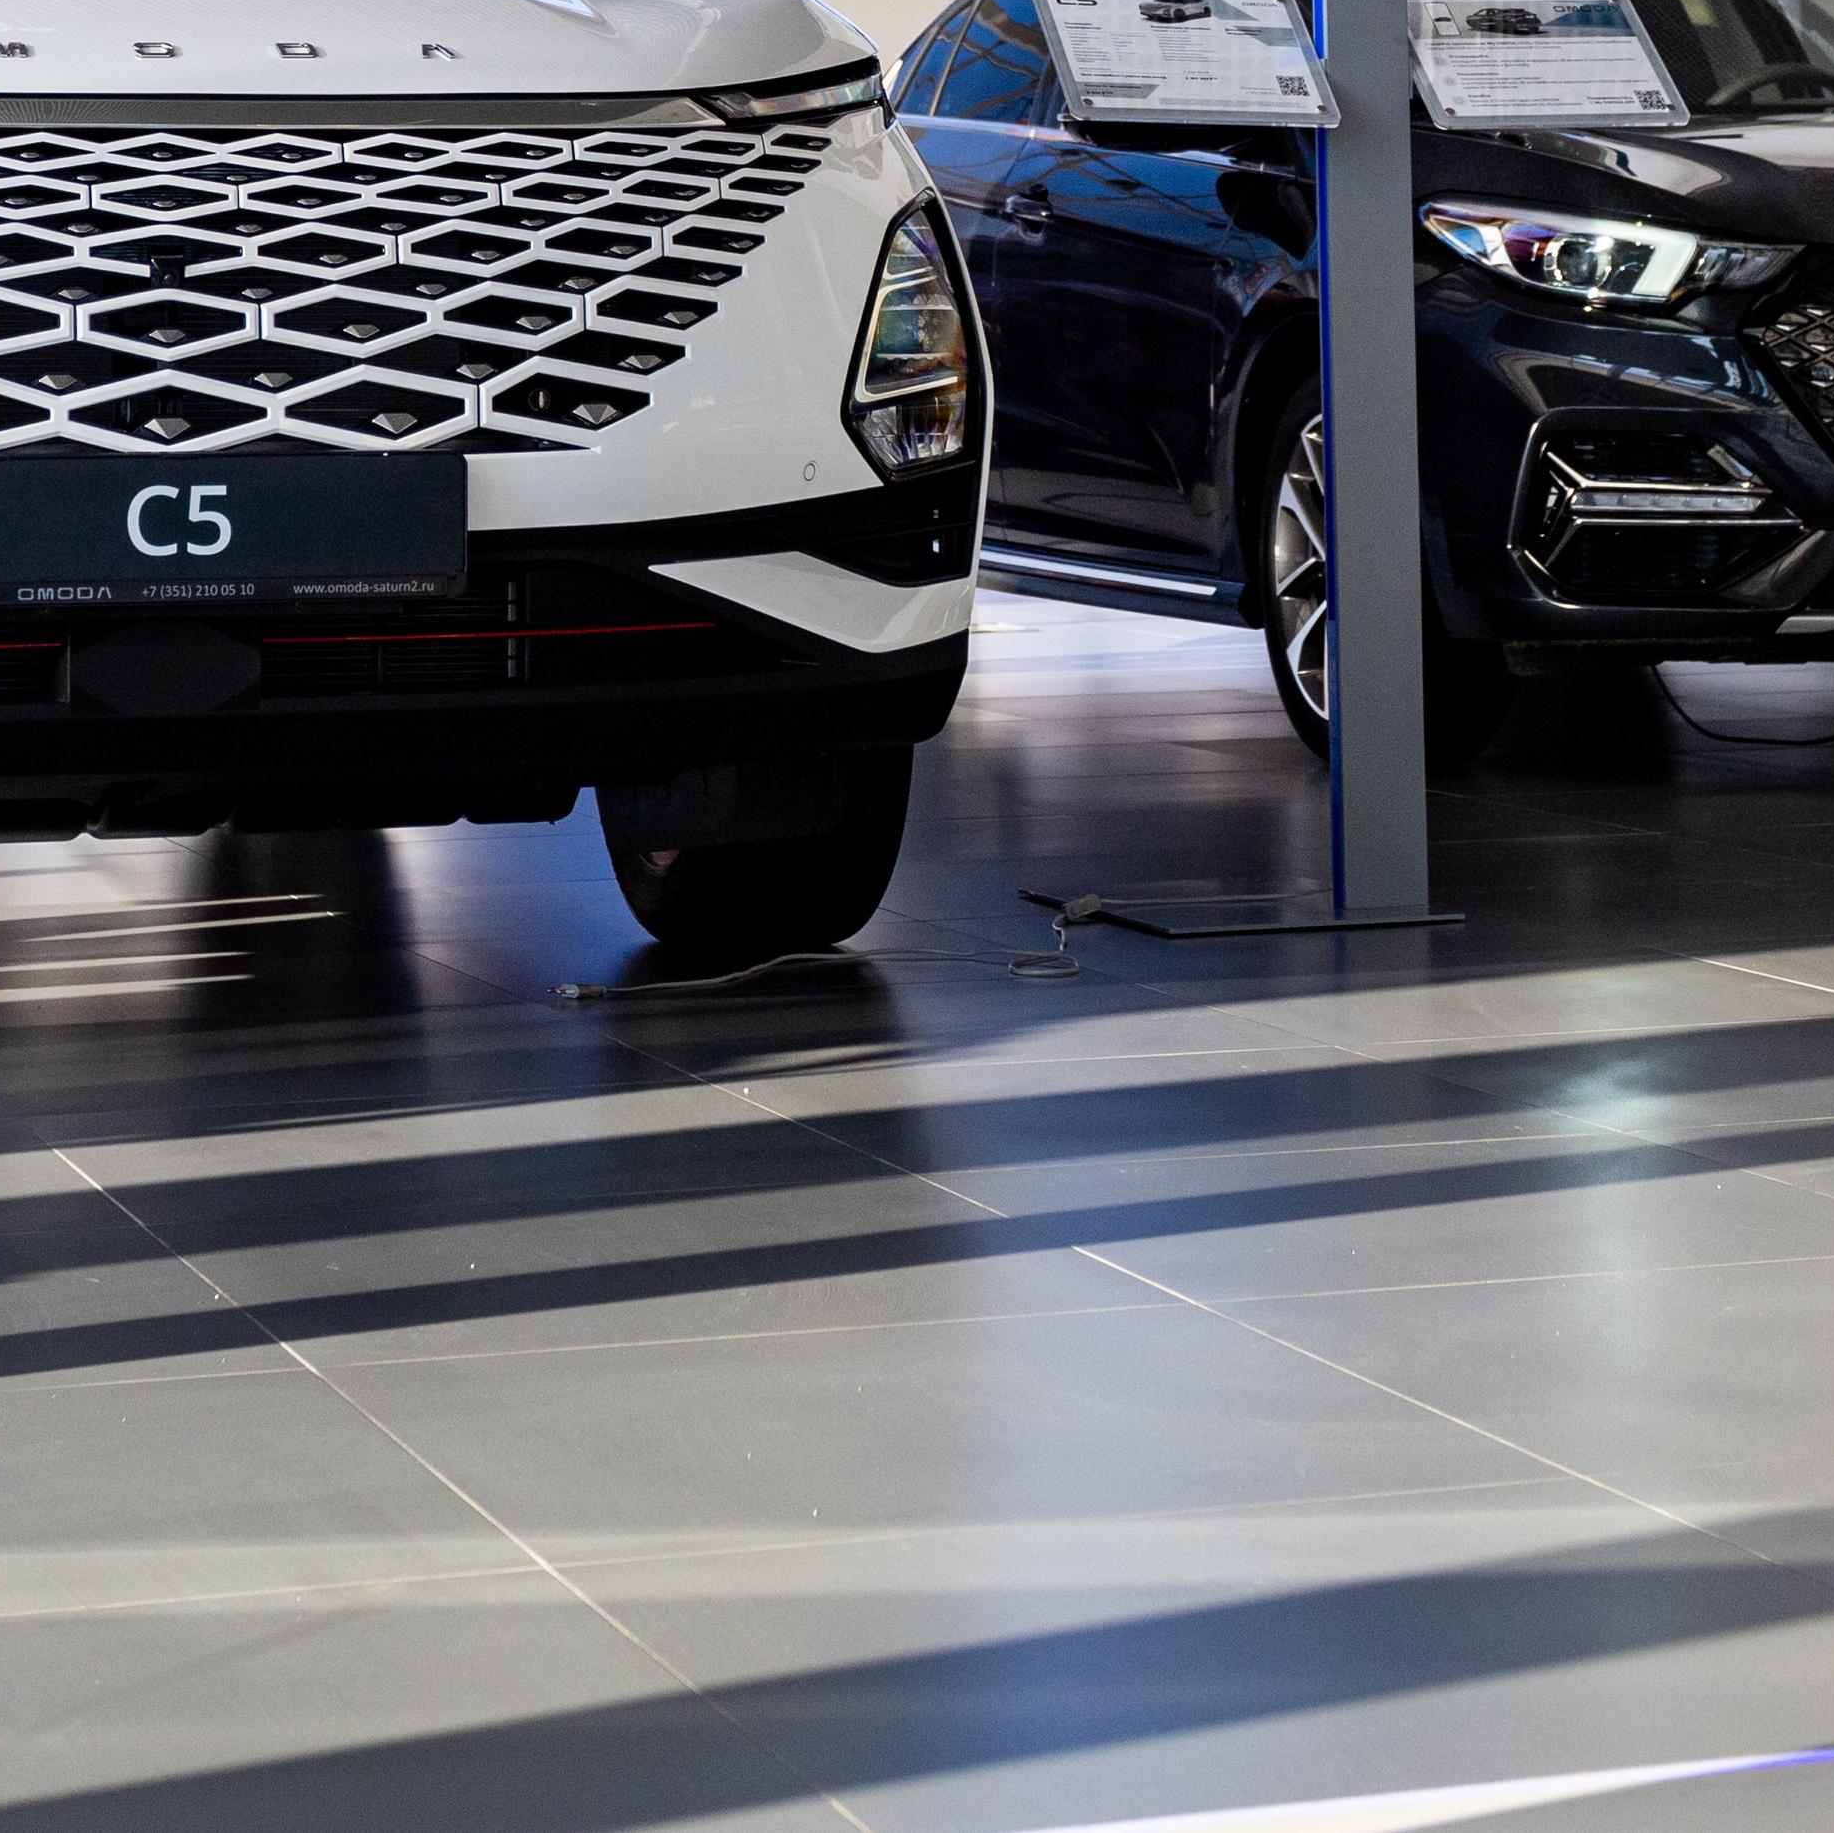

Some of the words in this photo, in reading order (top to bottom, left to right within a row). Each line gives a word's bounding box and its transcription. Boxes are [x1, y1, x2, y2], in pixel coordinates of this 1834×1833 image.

[125, 483, 234, 557] C5
[17, 587, 112, 601] OMODA
[141, 586, 156, 598] +7
[160, 585, 192, 599] (351)
[195, 585, 218, 597] 210
[220, 585, 236, 597] 05
[240, 584, 255, 596] 10
[293, 581, 435, 595] www.omoda-saturn2.ru
